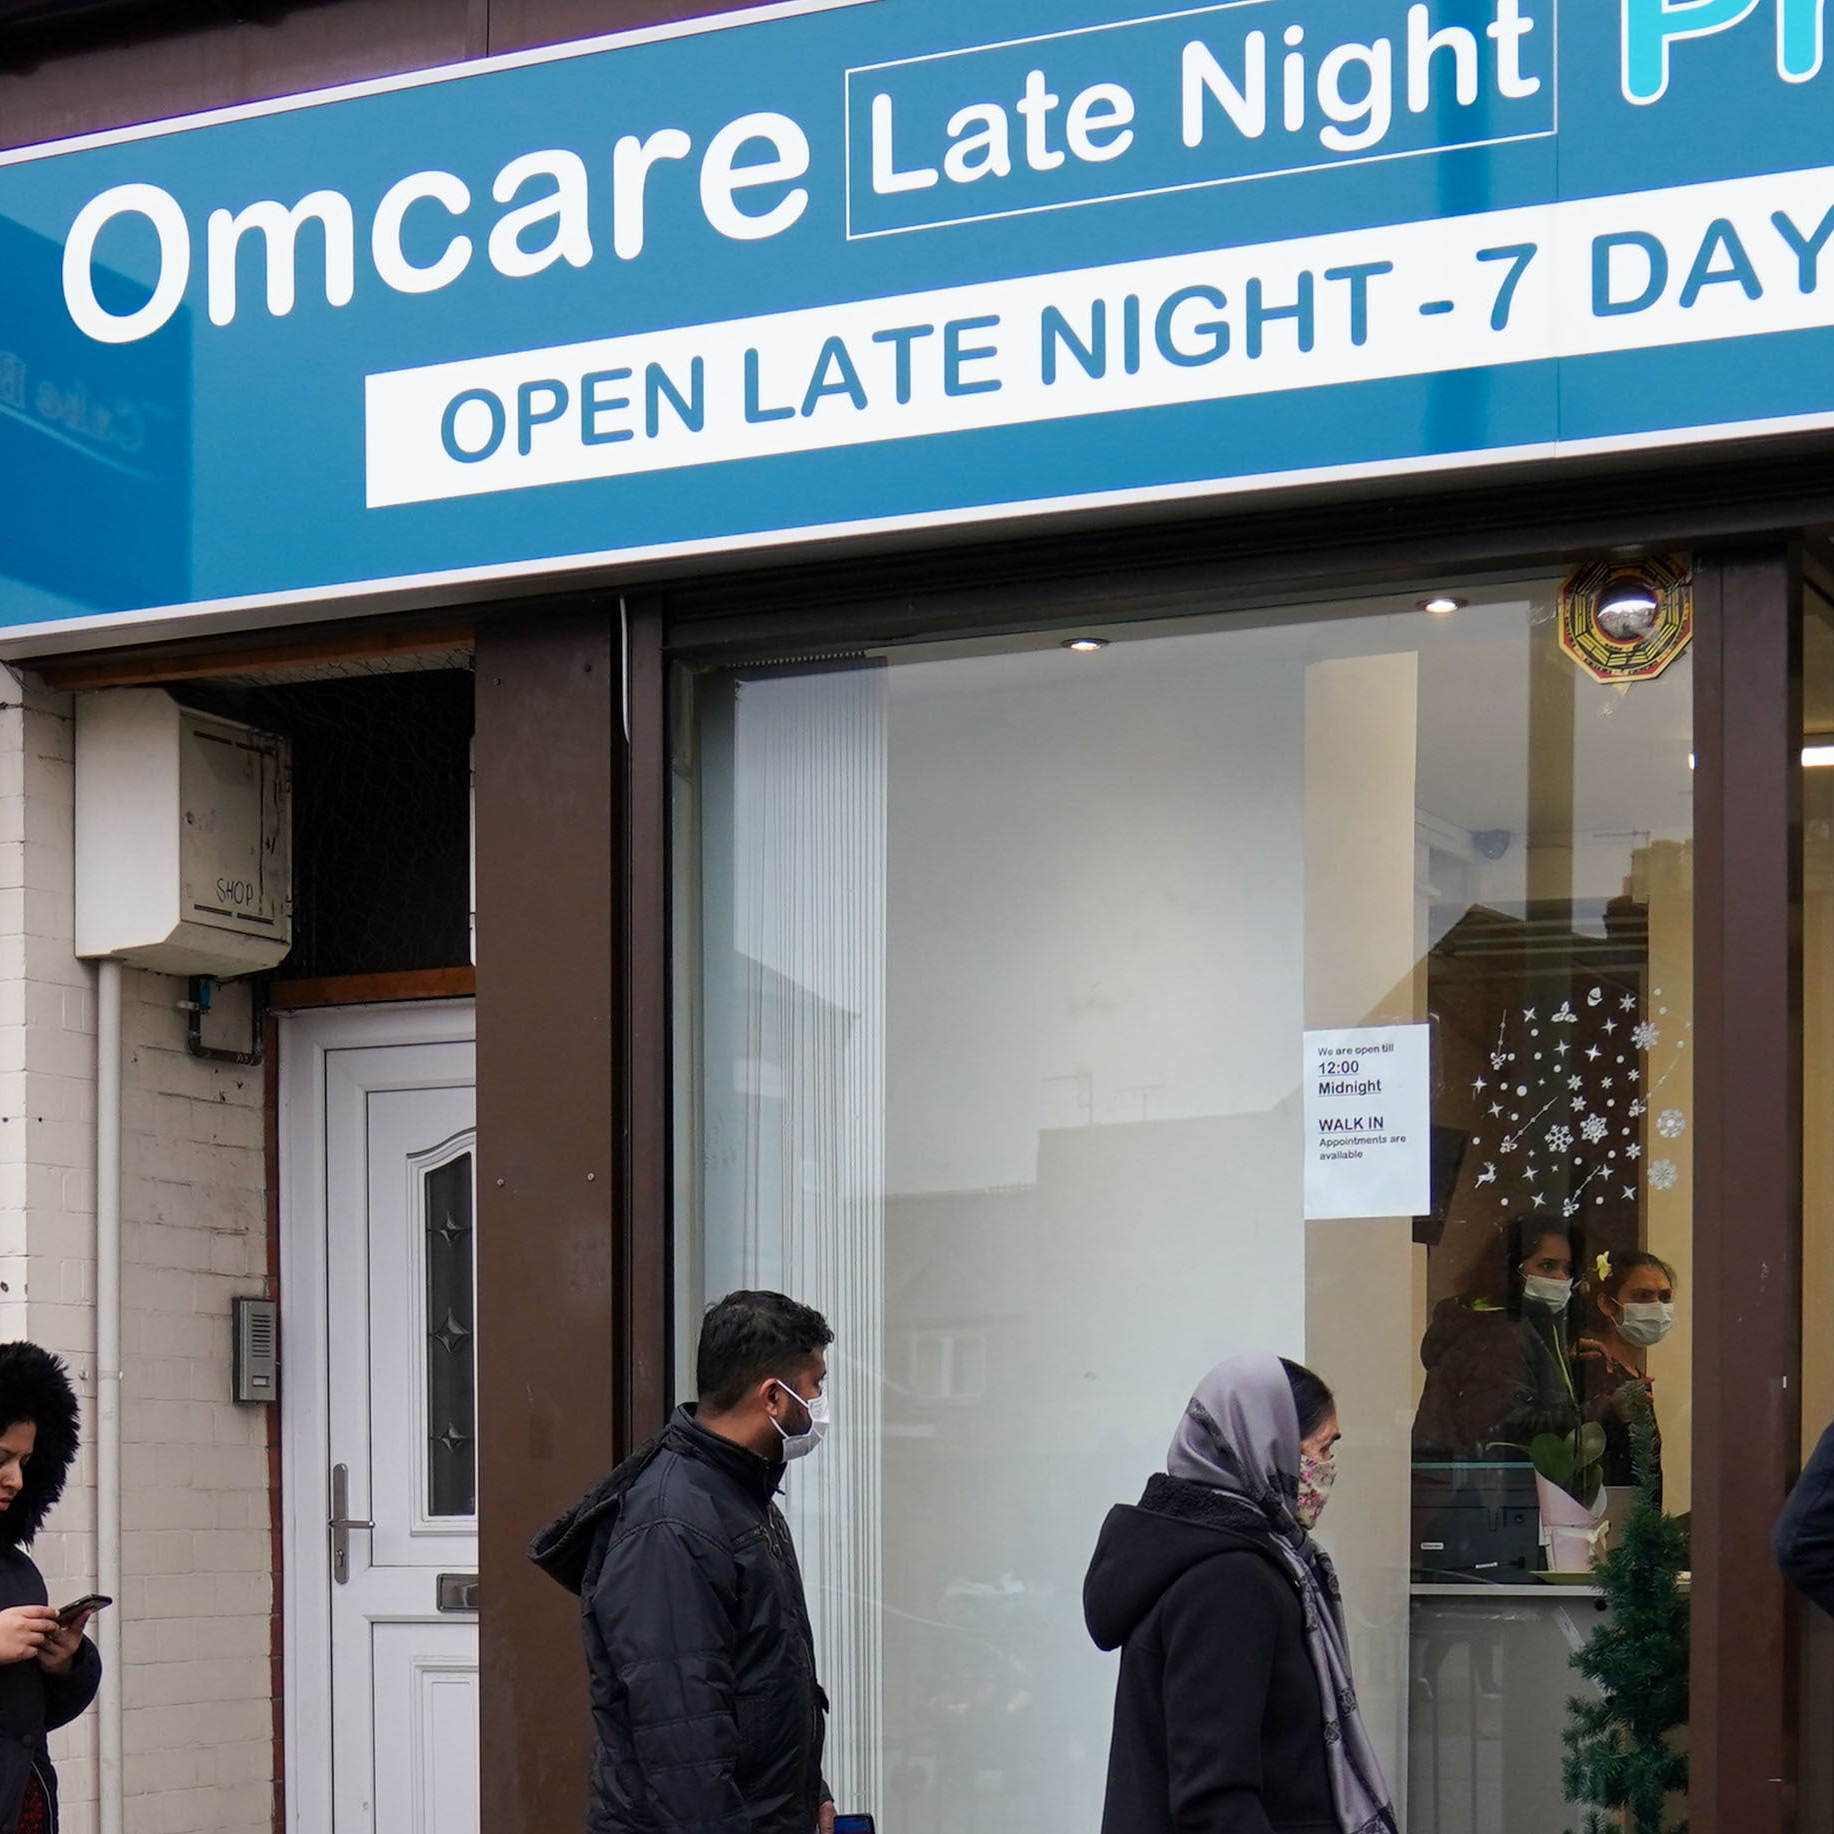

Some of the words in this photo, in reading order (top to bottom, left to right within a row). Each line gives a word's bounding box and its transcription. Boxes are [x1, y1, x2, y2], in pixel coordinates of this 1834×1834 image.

[63, 113, 809, 343] Omcare
[873, 70, 1134, 194] Late
[1183, 2, 1540, 151] Night
[441, 357, 704, 463] OPEN
[745, 315, 1002, 423] LATE
[216, 877, 254, 906] SHOP
[1355, 1047, 1380, 1056] open
[1318, 1060, 1359, 1075] 12:00
[1318, 1079, 1382, 1096] Midnight
[1319, 1117, 1364, 1132] WALK
[1368, 1116, 1384, 1129] IN
[1319, 1136, 1387, 1147] Appointments
[1390, 1136, 1406, 1144] are
[1319, 1150, 1363, 1160] available
